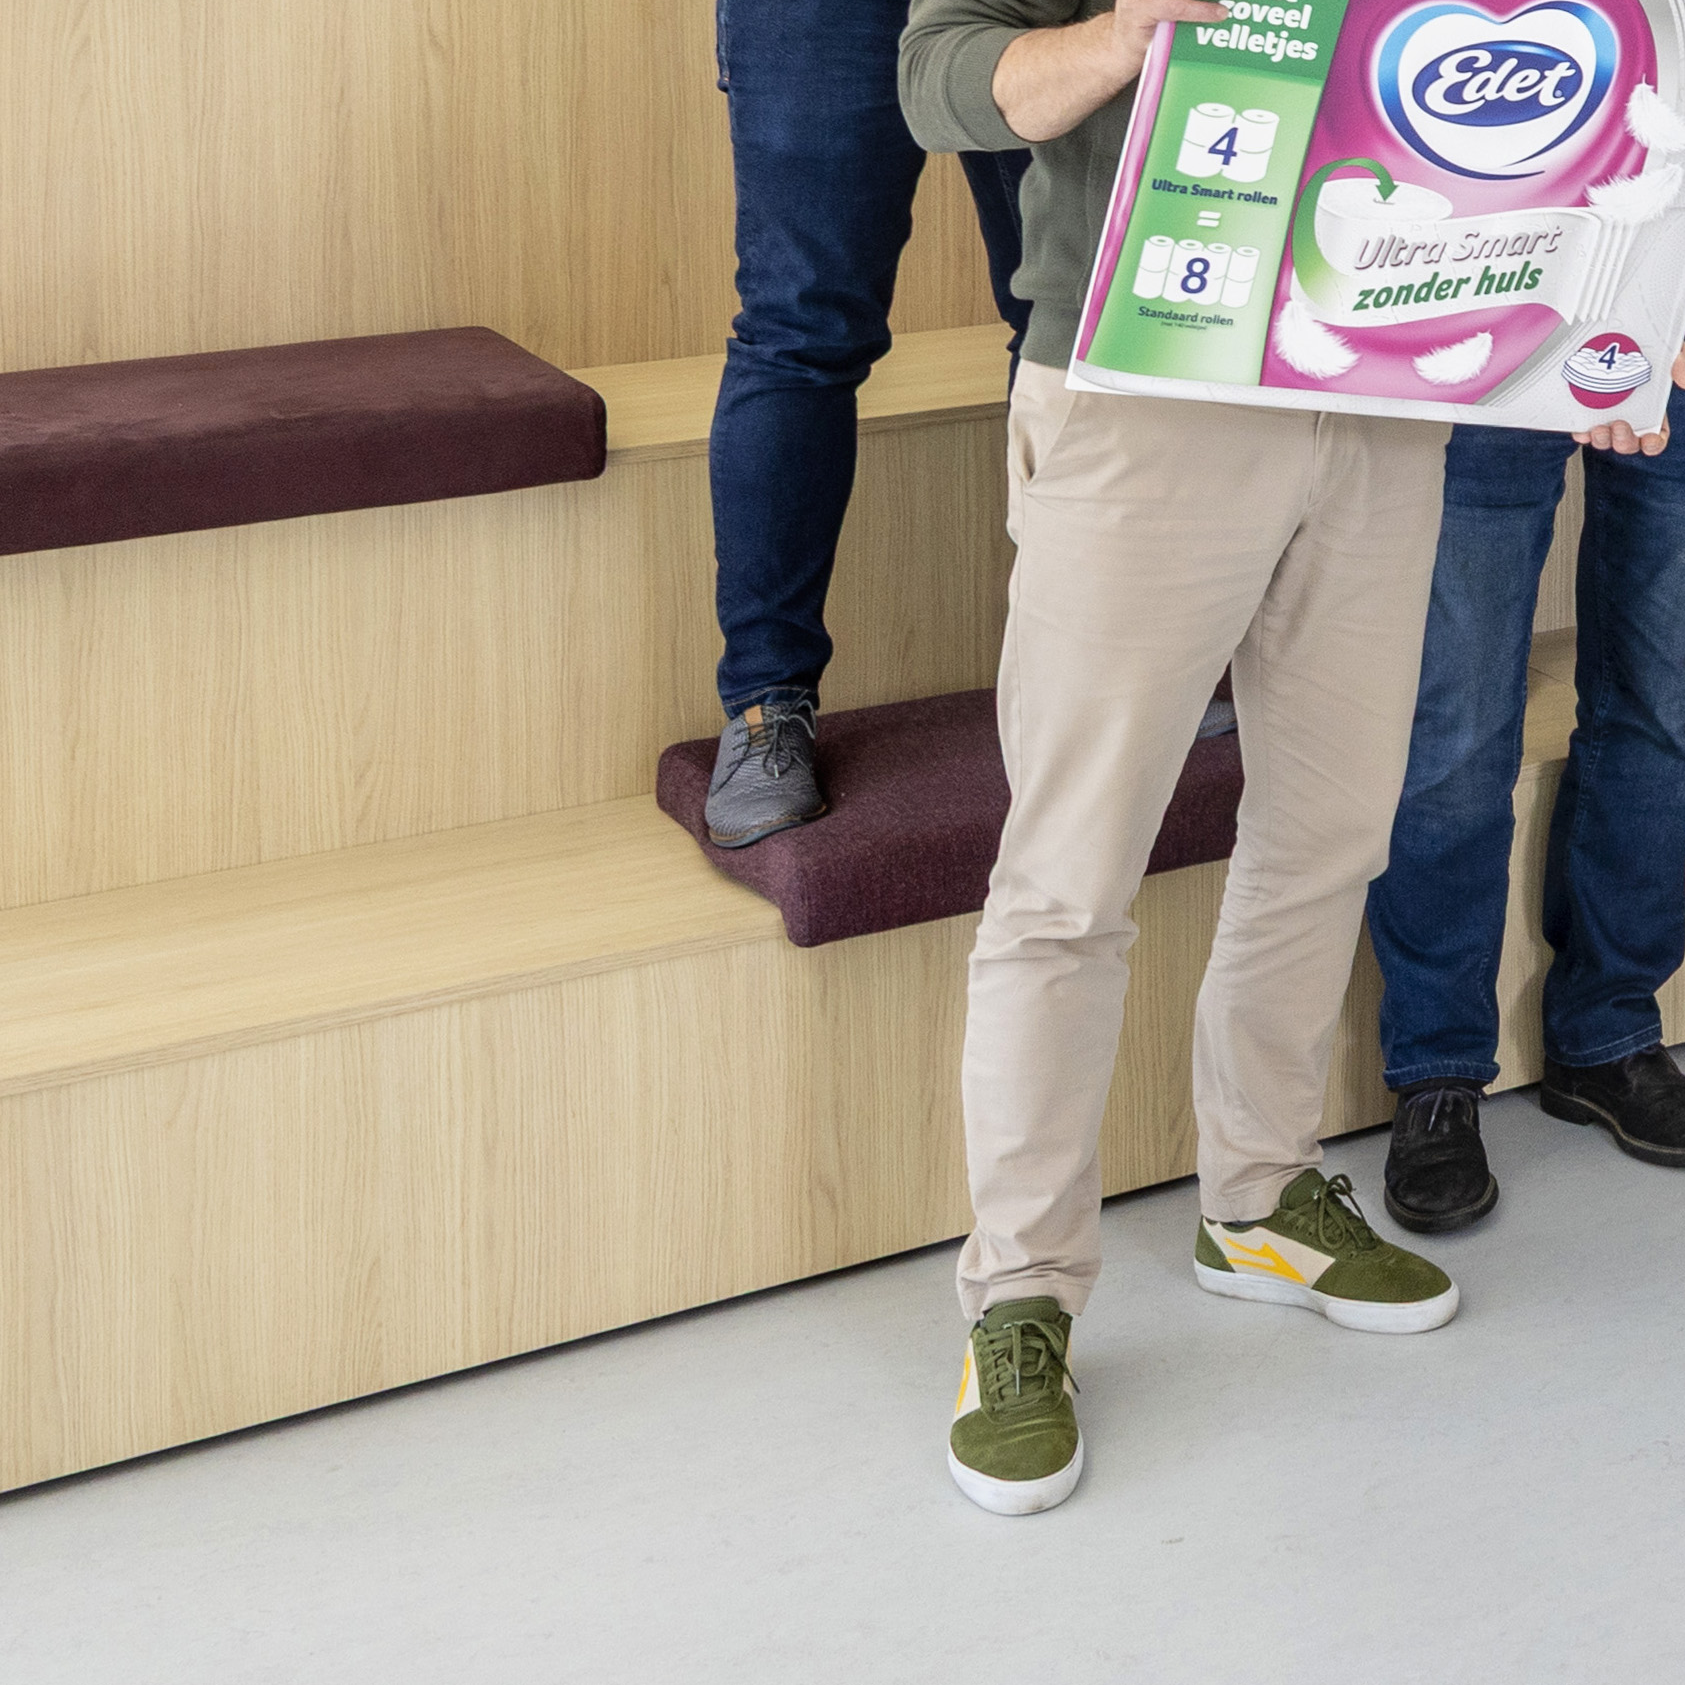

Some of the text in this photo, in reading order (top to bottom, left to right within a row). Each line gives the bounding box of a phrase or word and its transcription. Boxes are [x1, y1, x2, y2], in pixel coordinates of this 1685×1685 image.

[1195, 23, 1319, 63] velletjes
[1424, 48, 1577, 116] Edet
[1208, 126, 1239, 166] 4
[1152, 178, 1278, 206] Ultra Smart rollen
[1353, 225, 1564, 271] Ultra Smart
[1180, 257, 1211, 294] 8
[1352, 260, 1544, 312] zonder huls
[1138, 305, 1200, 323] Standaard
[1200, 314, 1234, 326] rollen
[1598, 344, 1619, 370] 4
